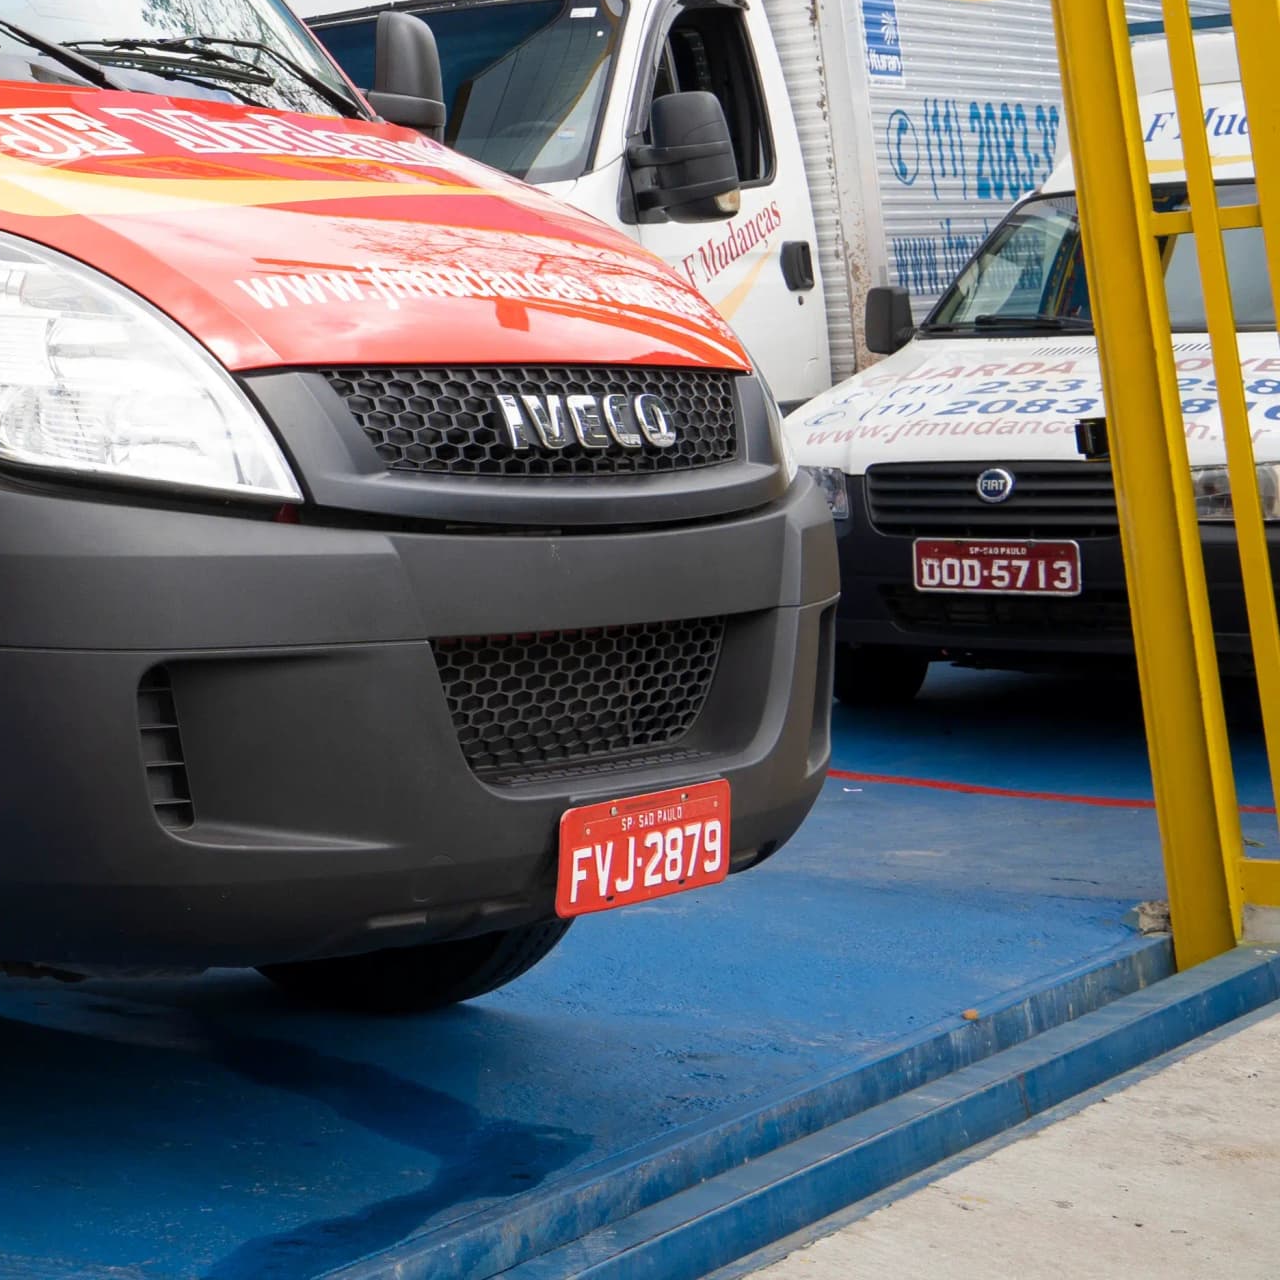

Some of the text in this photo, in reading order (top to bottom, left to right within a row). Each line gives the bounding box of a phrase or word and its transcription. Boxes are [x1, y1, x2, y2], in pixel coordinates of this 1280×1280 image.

[924, 98, 967, 201] (11)
[698, 200, 782, 284] Mudanças
[860, 360, 1078, 388] GUARDA
[496, 393, 677, 449] IVECO
[859, 398, 1100, 421] (11) 2083
[981, 478, 1006, 491] FIAT
